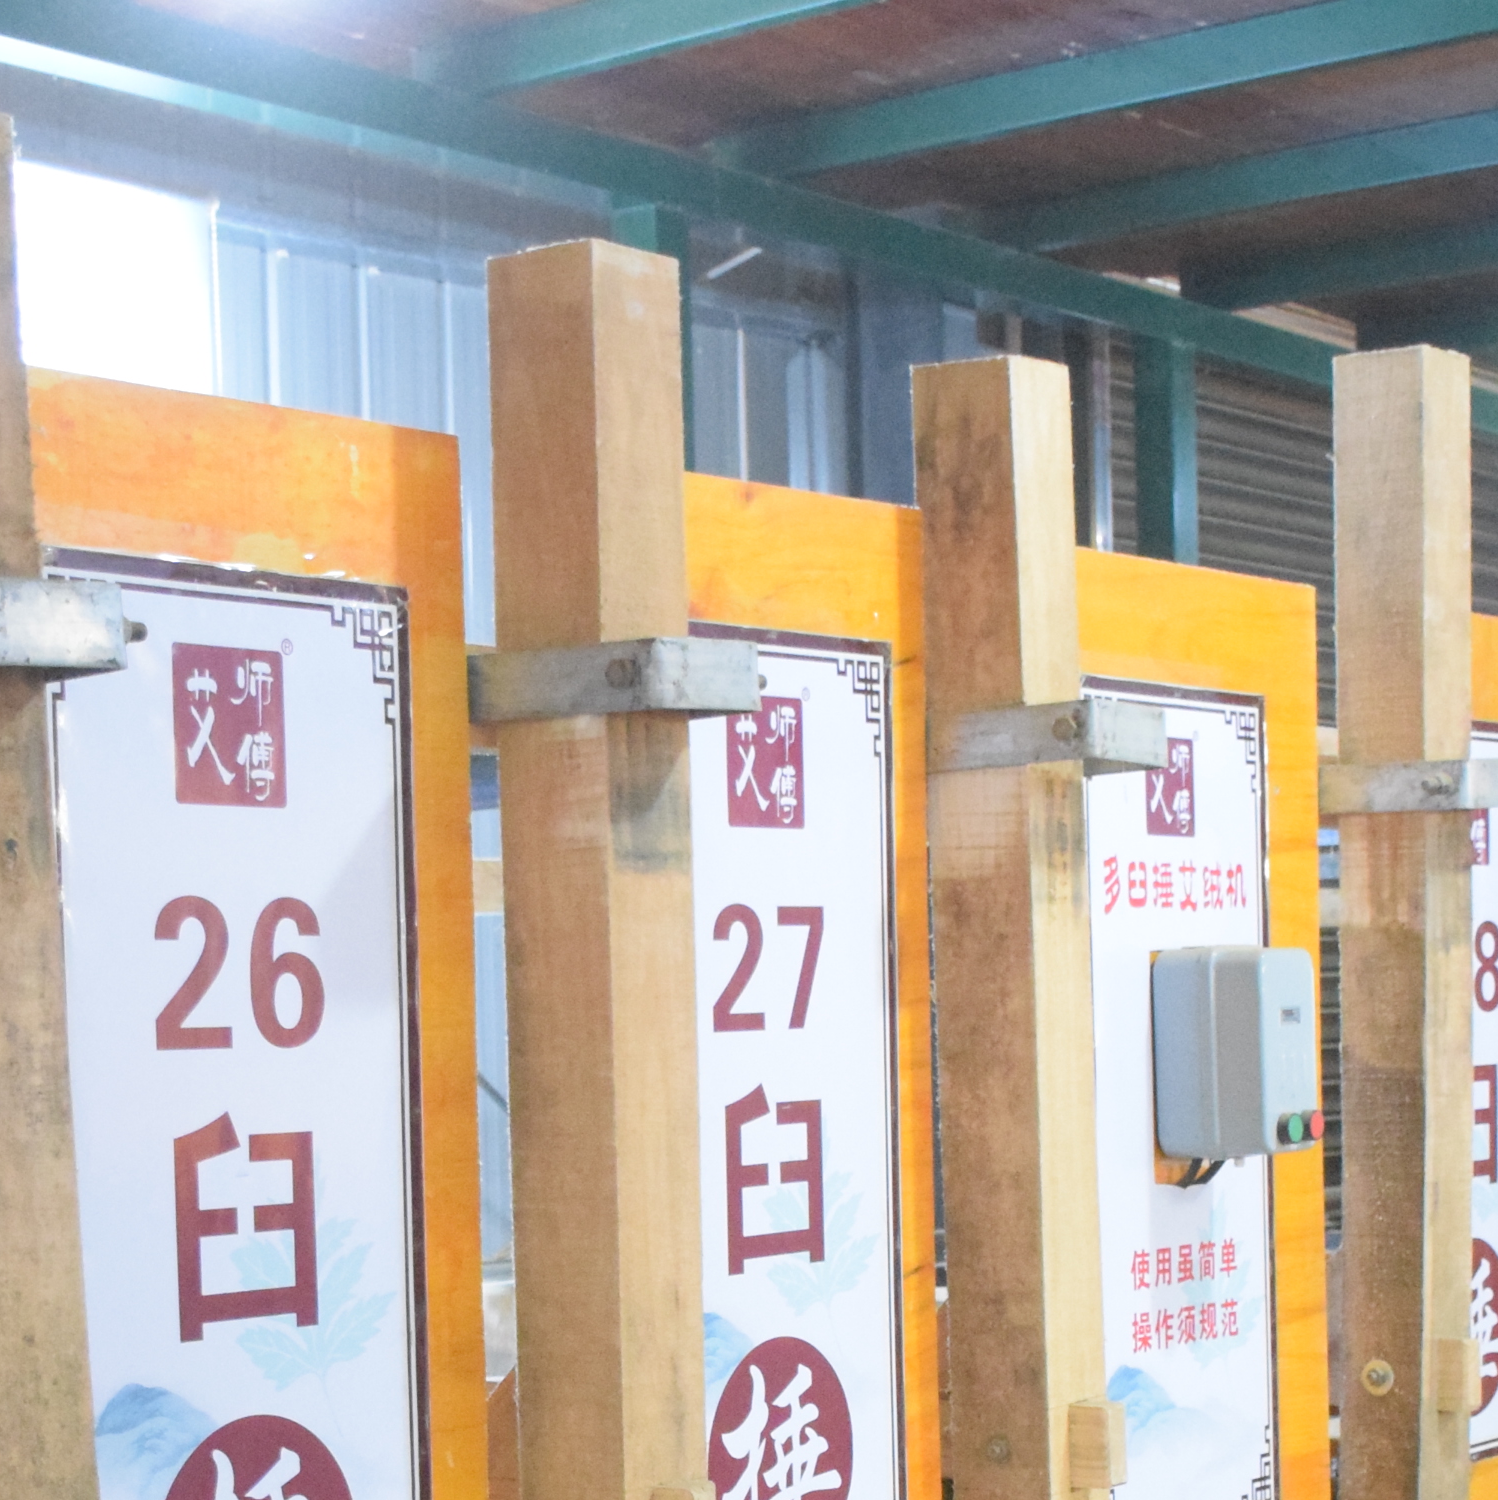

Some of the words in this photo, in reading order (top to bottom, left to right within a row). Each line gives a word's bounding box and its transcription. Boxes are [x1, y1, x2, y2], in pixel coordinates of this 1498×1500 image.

[154, 895, 326, 1051] 26
[712, 903, 825, 1033] 27
[173, 1111, 319, 1343] 臼
[724, 1083, 825, 1276] 臼
[1130, 1237, 1238, 1291] 使用虽简单
[1131, 1298, 1240, 1354] 操作须规范
